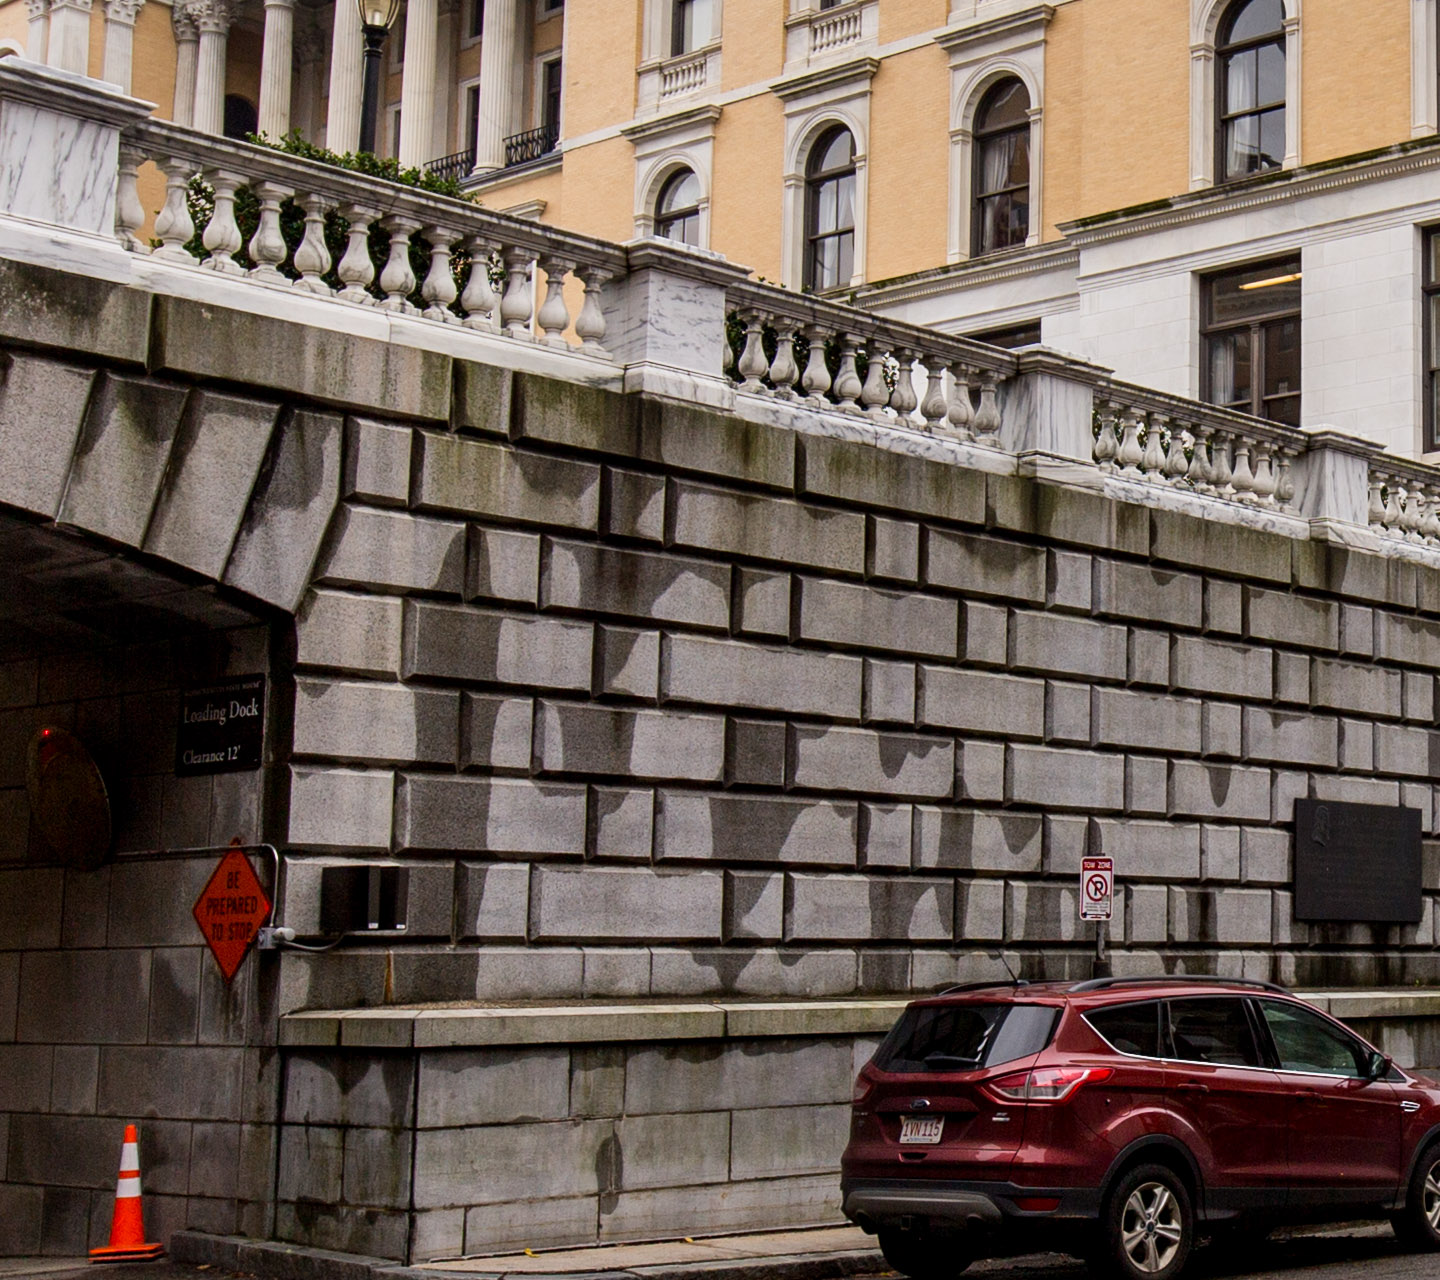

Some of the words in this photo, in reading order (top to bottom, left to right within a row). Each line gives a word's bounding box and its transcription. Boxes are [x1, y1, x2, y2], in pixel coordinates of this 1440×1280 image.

[184, 704, 227, 725] Loading
[229, 697, 259, 718] Dock
[183, 749, 225, 764] Clearance
[226, 871, 241, 889] BE
[206, 896, 258, 916] PREPARED
[211, 923, 223, 941] TO
[228, 921, 253, 941] STOP
